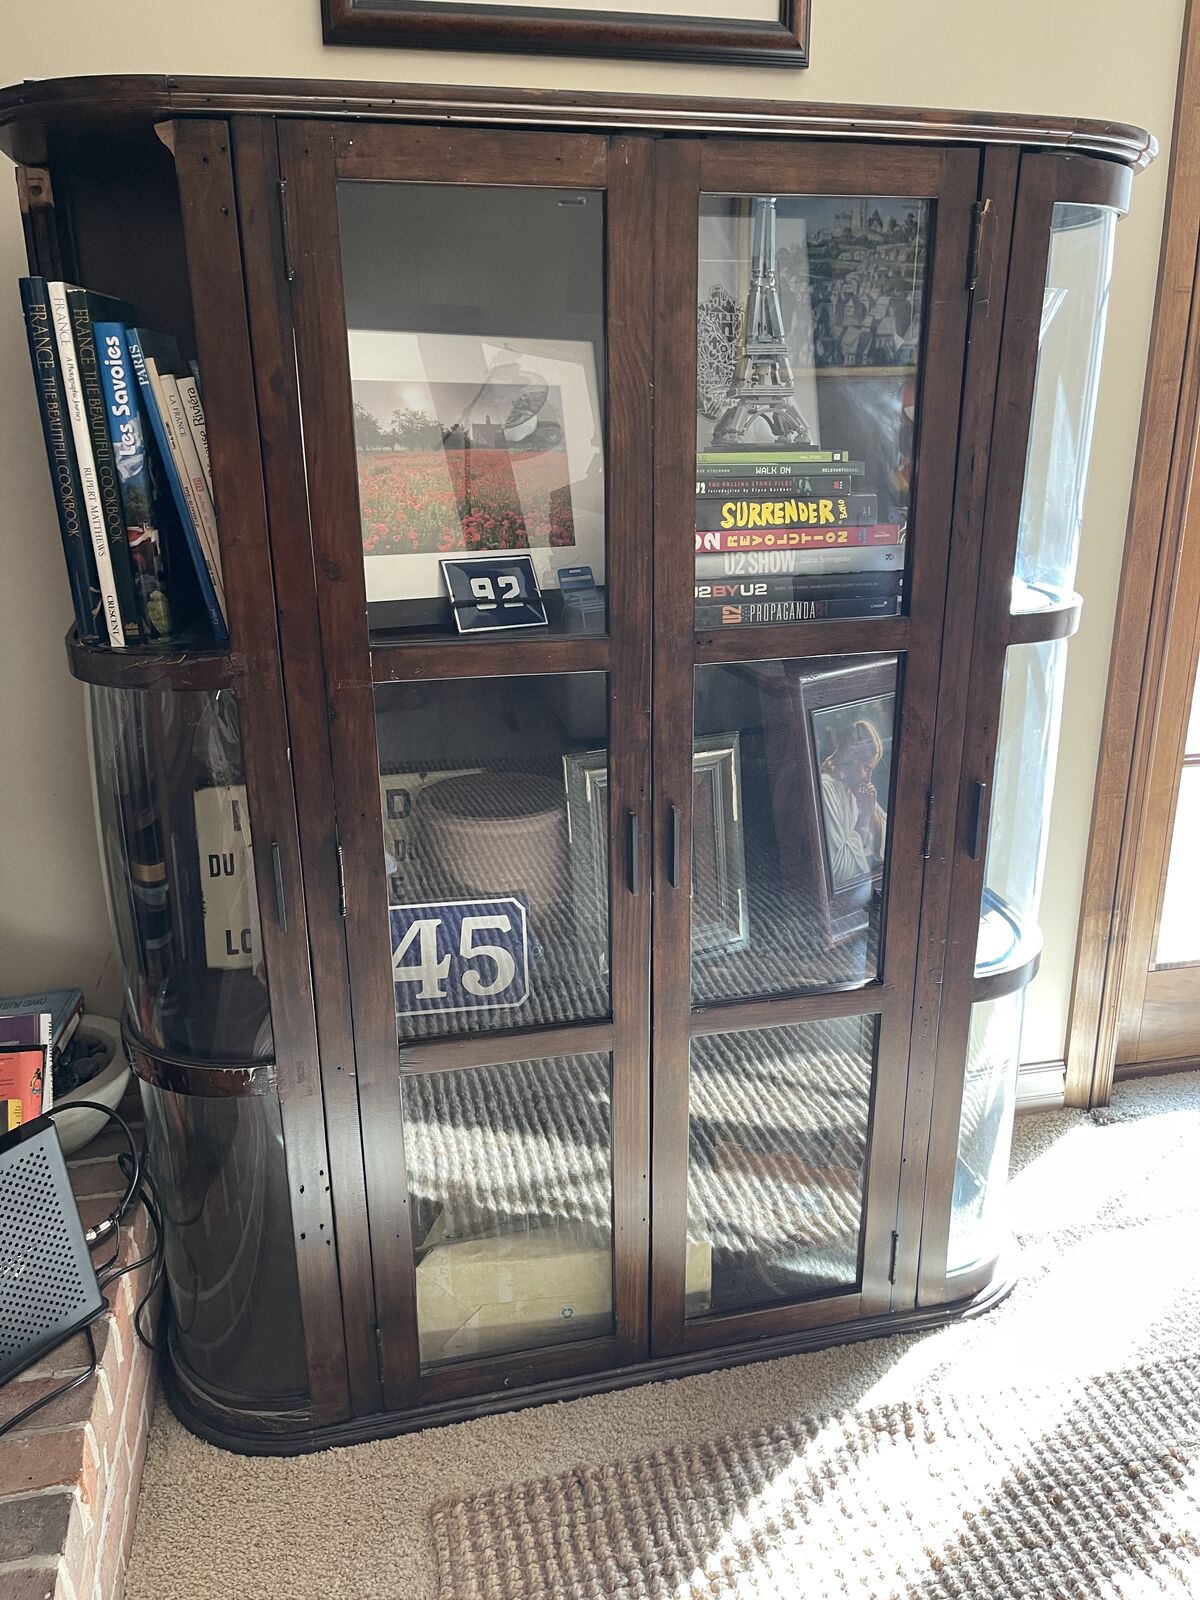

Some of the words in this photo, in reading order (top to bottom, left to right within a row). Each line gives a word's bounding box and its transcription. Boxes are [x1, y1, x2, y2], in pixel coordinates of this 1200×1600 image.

[29, 303, 55, 369] FRANCE
[73, 308, 96, 365] FRANCE
[83, 370, 100, 395] THE
[104, 335, 131, 417] Savoies
[129, 344, 150, 386] PARIS
[43, 376, 59, 402] THE
[47, 403, 68, 462] BEAUTIFUL
[87, 398, 110, 462] BEAUTIFUL
[119, 423, 136, 456] Les
[172, 407, 188, 438] FRANCE
[53, 297, 72, 346] FRANCE
[83, 467, 97, 502] RUPERT
[90, 505, 106, 557] MATTHEWS
[106, 595, 120, 635] CRESCENT
[755, 466, 777, 475] WALK
[780, 466, 791, 474] ON
[57, 465, 81, 537] COOKBOOK
[100, 465, 124, 544] COOKBOOK
[720, 498, 835, 529] SURRENDER
[839, 499, 847, 519] BONO
[727, 531, 848, 547] REVOLUTION
[724, 551, 746, 575] U2
[747, 550, 796, 574] SHOW
[470, 575, 524, 610] 92
[722, 604, 742, 624] U2
[750, 601, 816, 622] PROPAGANDA
[208, 852, 235, 877] DU
[392, 914, 516, 1000] 45
